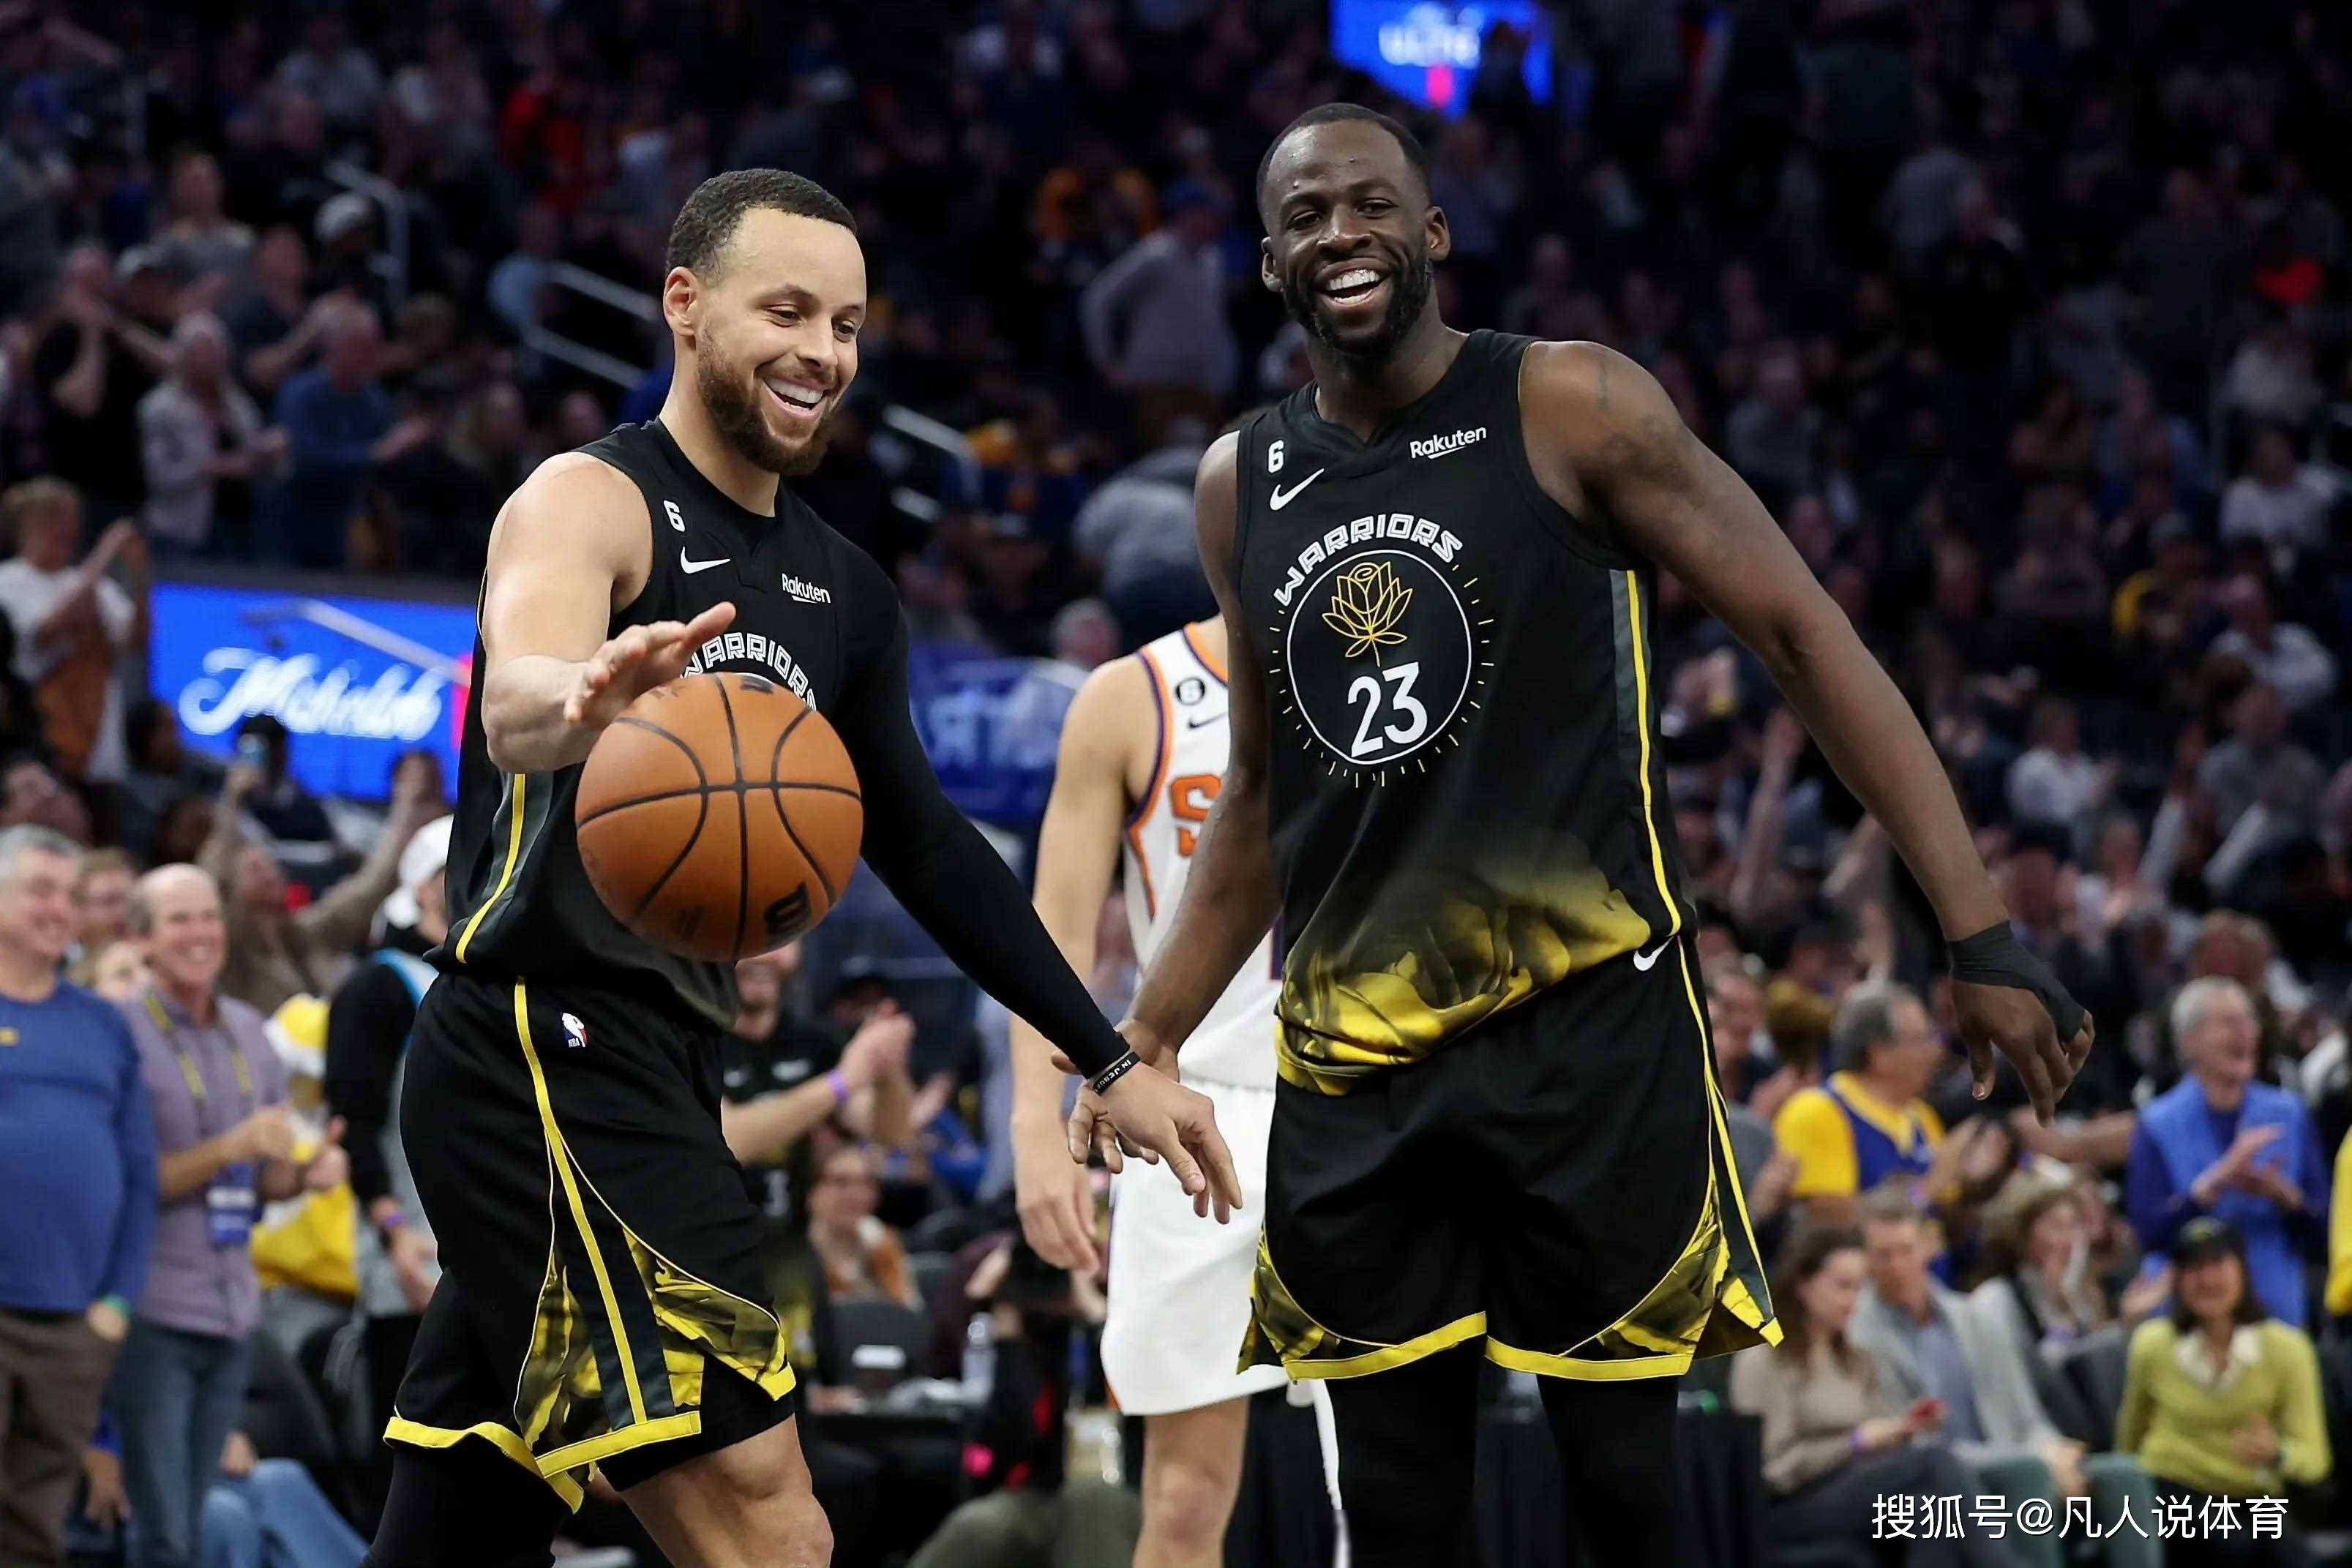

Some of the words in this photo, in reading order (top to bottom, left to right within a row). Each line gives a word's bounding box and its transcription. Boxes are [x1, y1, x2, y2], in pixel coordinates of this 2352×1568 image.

[1267, 440, 1284, 473] 6
[1409, 427, 1487, 459] Rakuten
[663, 500, 686, 532] 6
[1274, 513, 1463, 606] WARRIORS
[782, 573, 831, 604] Rakuten
[1347, 661, 1428, 757] 23
